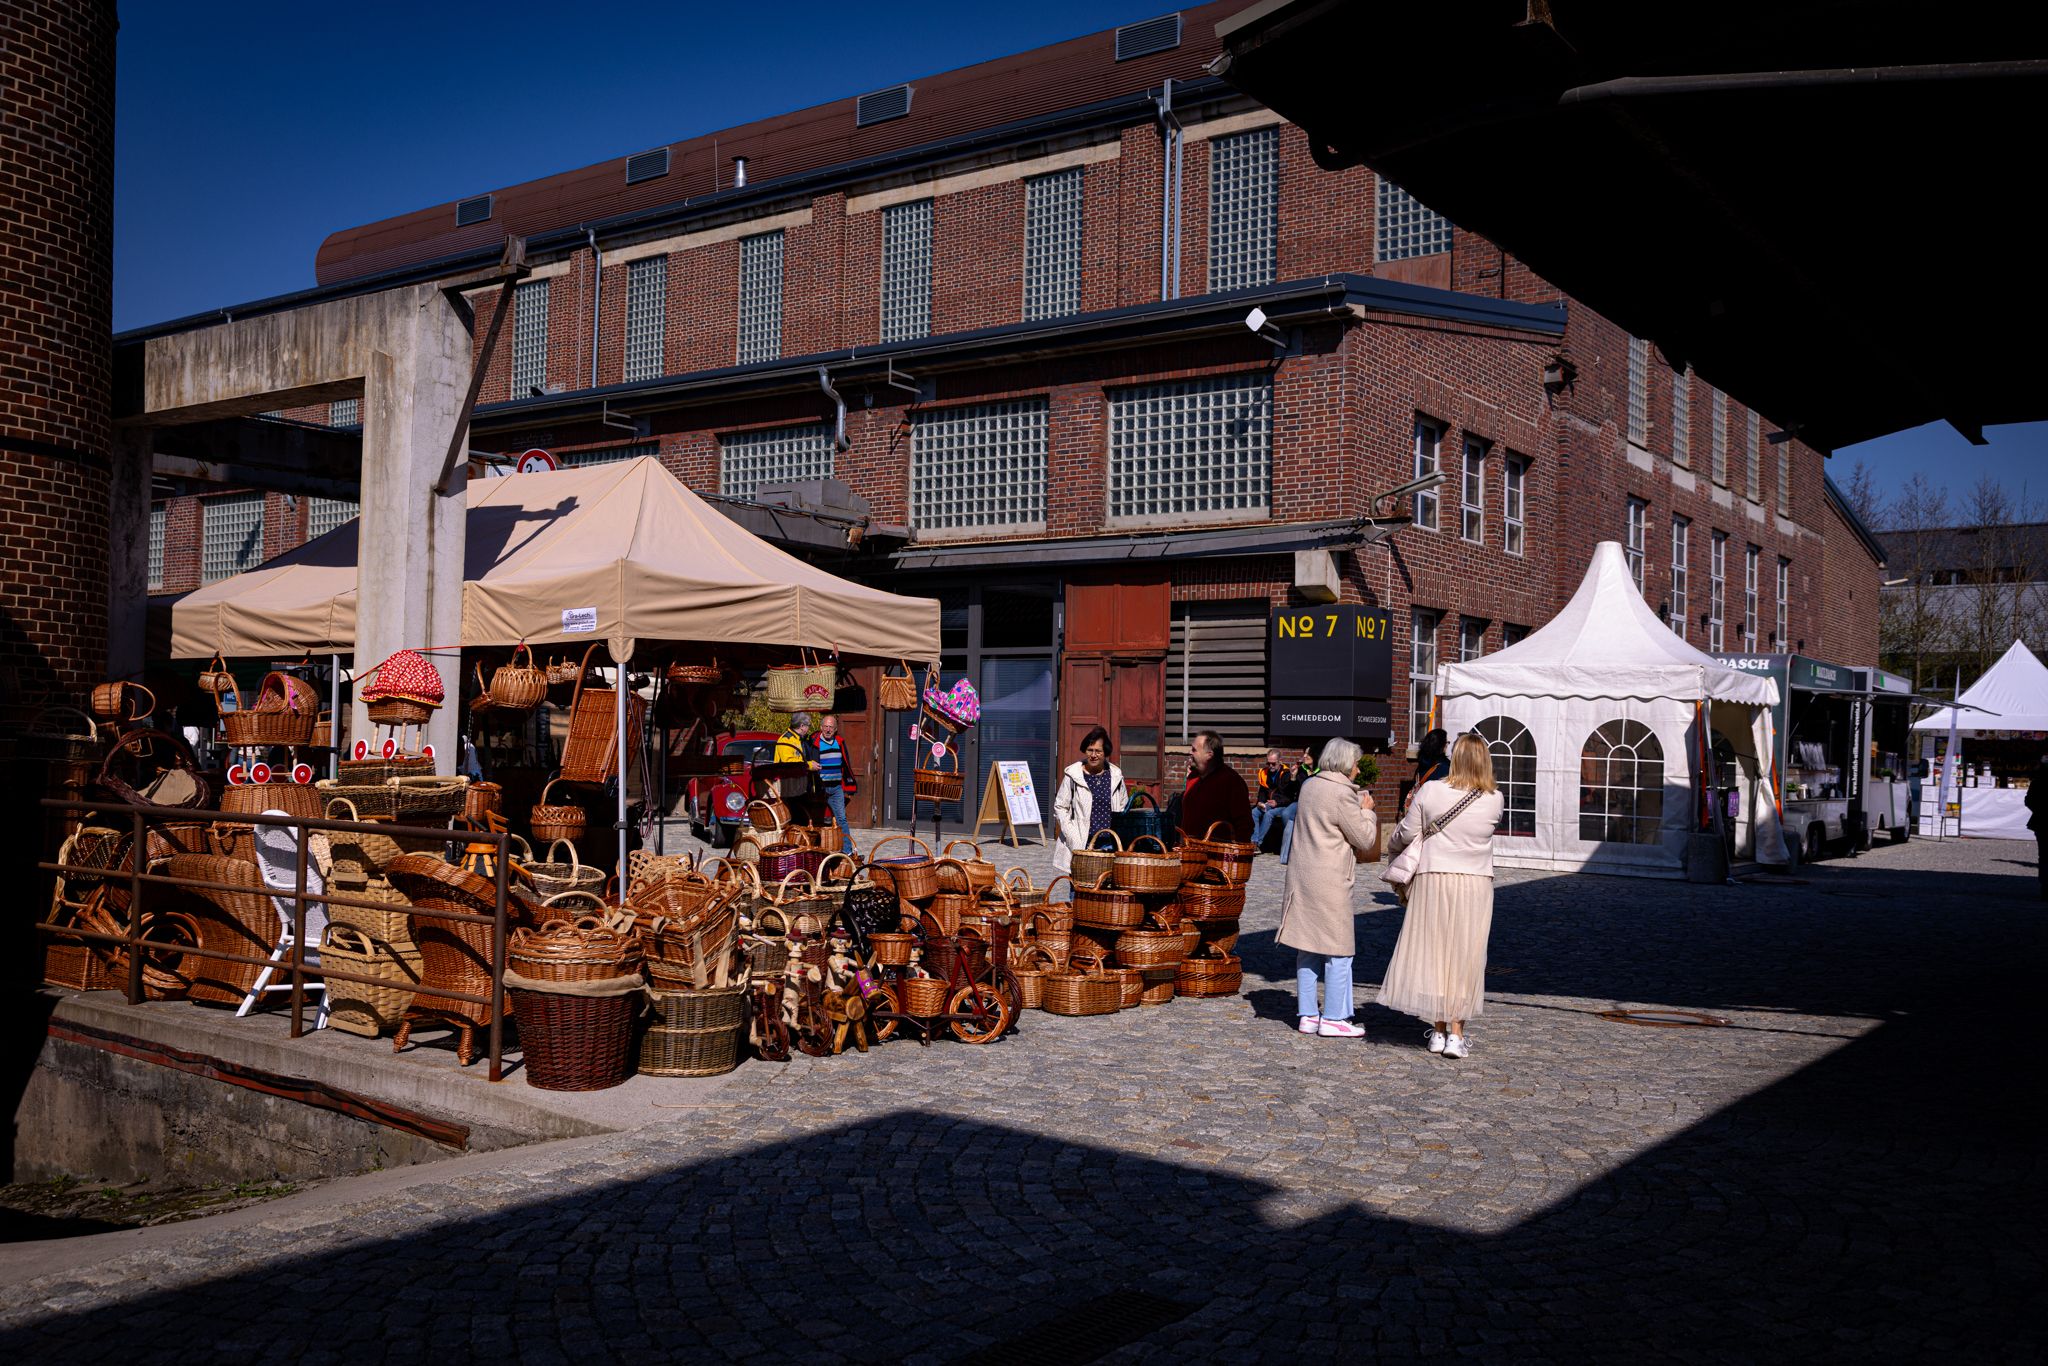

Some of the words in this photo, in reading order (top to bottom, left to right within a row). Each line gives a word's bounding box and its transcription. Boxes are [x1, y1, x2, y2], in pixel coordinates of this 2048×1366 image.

[1325, 615, 1338, 637] 7
[1380, 619, 1387, 640] 7
[1281, 714, 1341, 722] SCHMIEDEDOM
